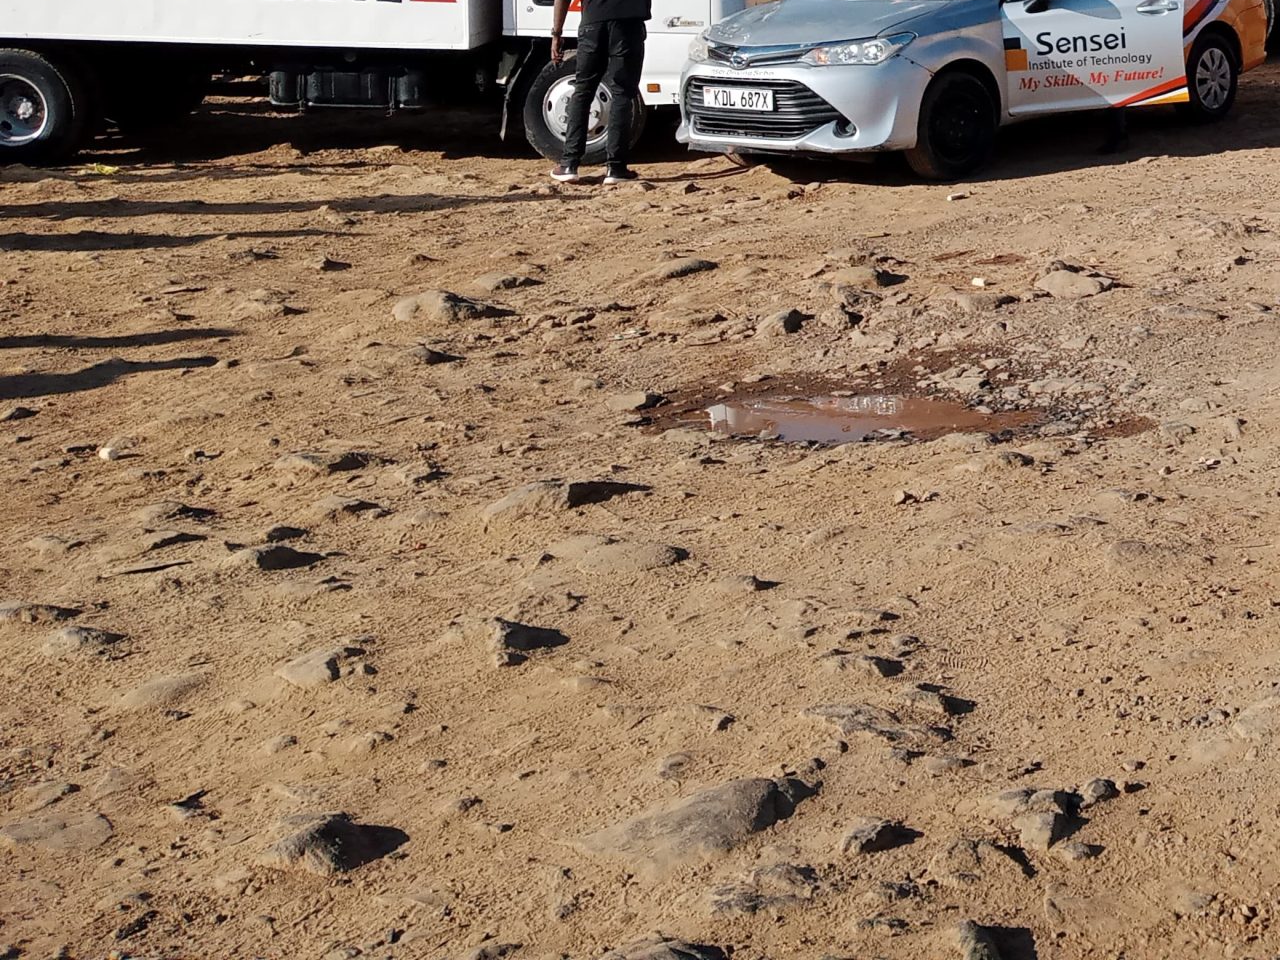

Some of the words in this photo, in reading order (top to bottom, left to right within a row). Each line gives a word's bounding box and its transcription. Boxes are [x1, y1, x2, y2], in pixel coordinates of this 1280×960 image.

[1036, 26, 1126, 56] Sensei
[1028, 56, 1073, 72] Institute
[1076, 56, 1088, 68] of
[1090, 53, 1153, 68] Technology
[1019, 77, 1041, 93] My
[1043, 73, 1084, 89] Skills,
[1088, 72, 1110, 86] My
[1114, 66, 1164, 81] Future!
[713, 90, 736, 107] KDL
[740, 91, 769, 109] 687X
